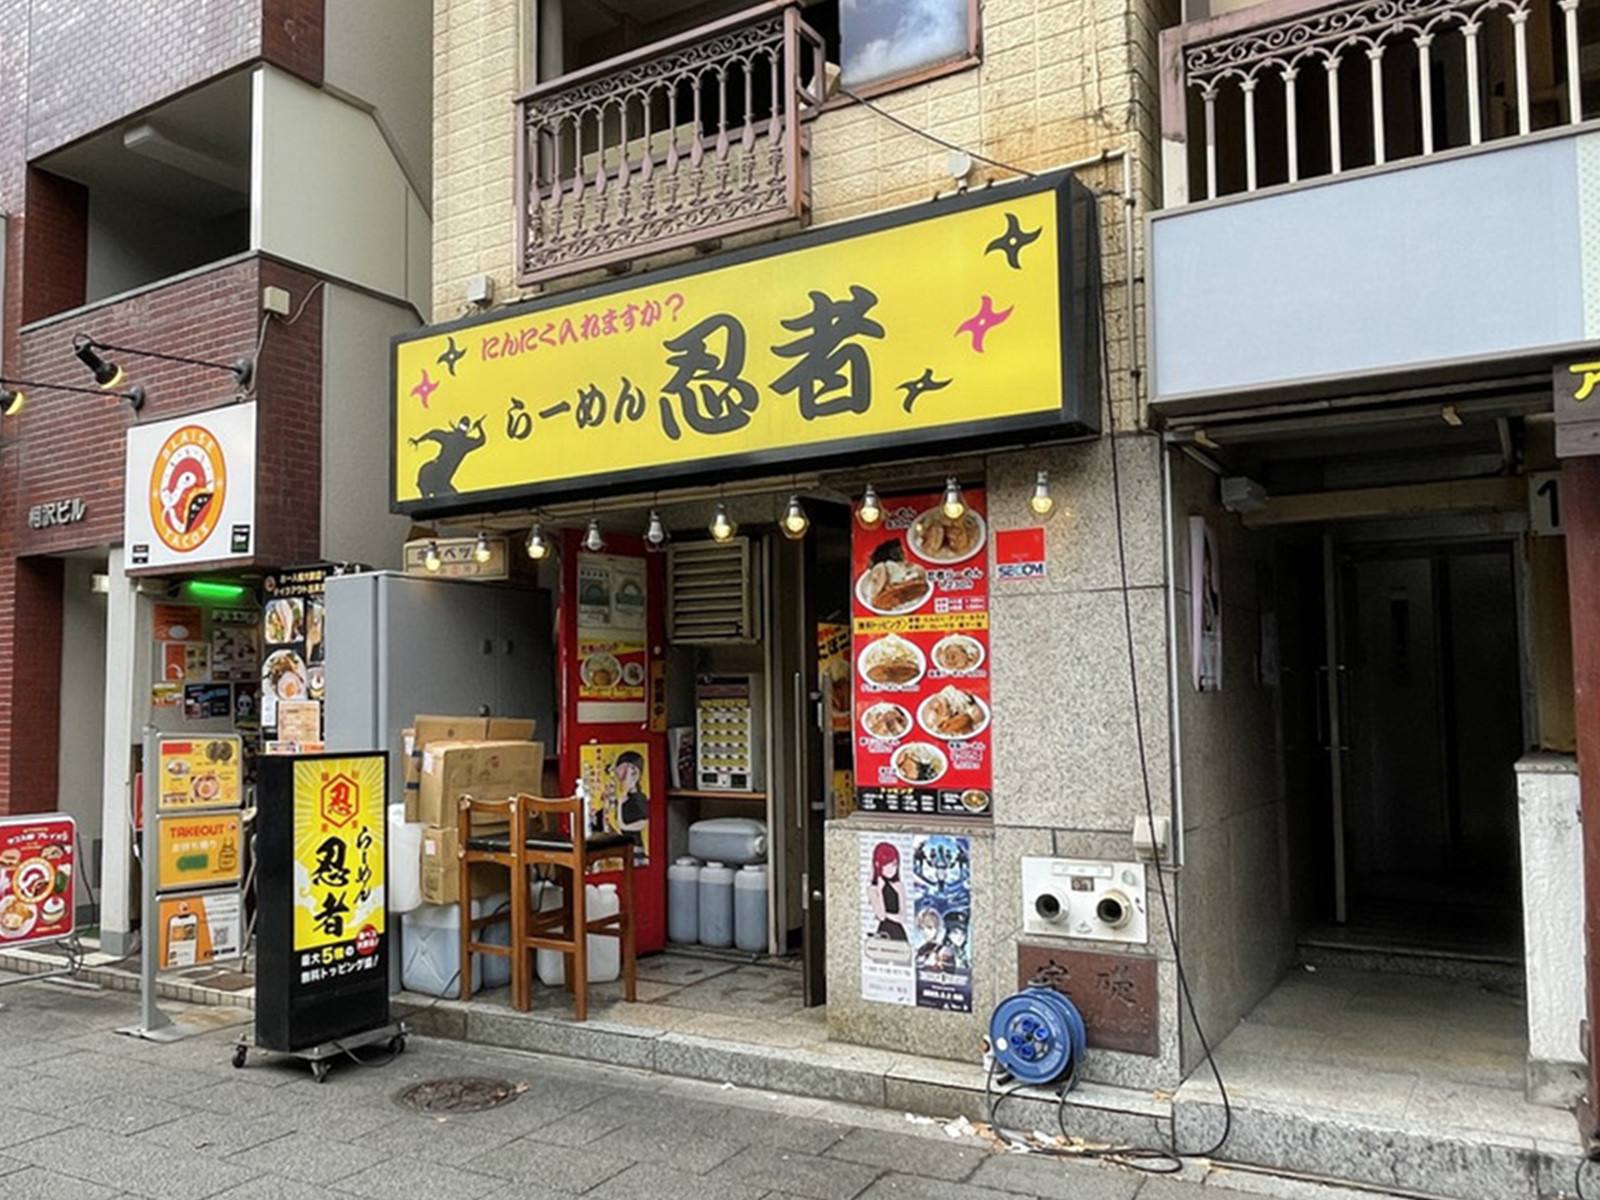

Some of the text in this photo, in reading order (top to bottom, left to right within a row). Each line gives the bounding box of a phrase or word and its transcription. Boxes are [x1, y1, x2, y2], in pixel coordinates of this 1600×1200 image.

[481, 293, 685, 361] にんにく入れますか？
[1537, 478, 1560, 528] 1
[164, 523, 211, 548] TACOS
[327, 781, 353, 817] 忍
[312, 835, 352, 938] 忍者
[353, 825, 374, 905] らーめん
